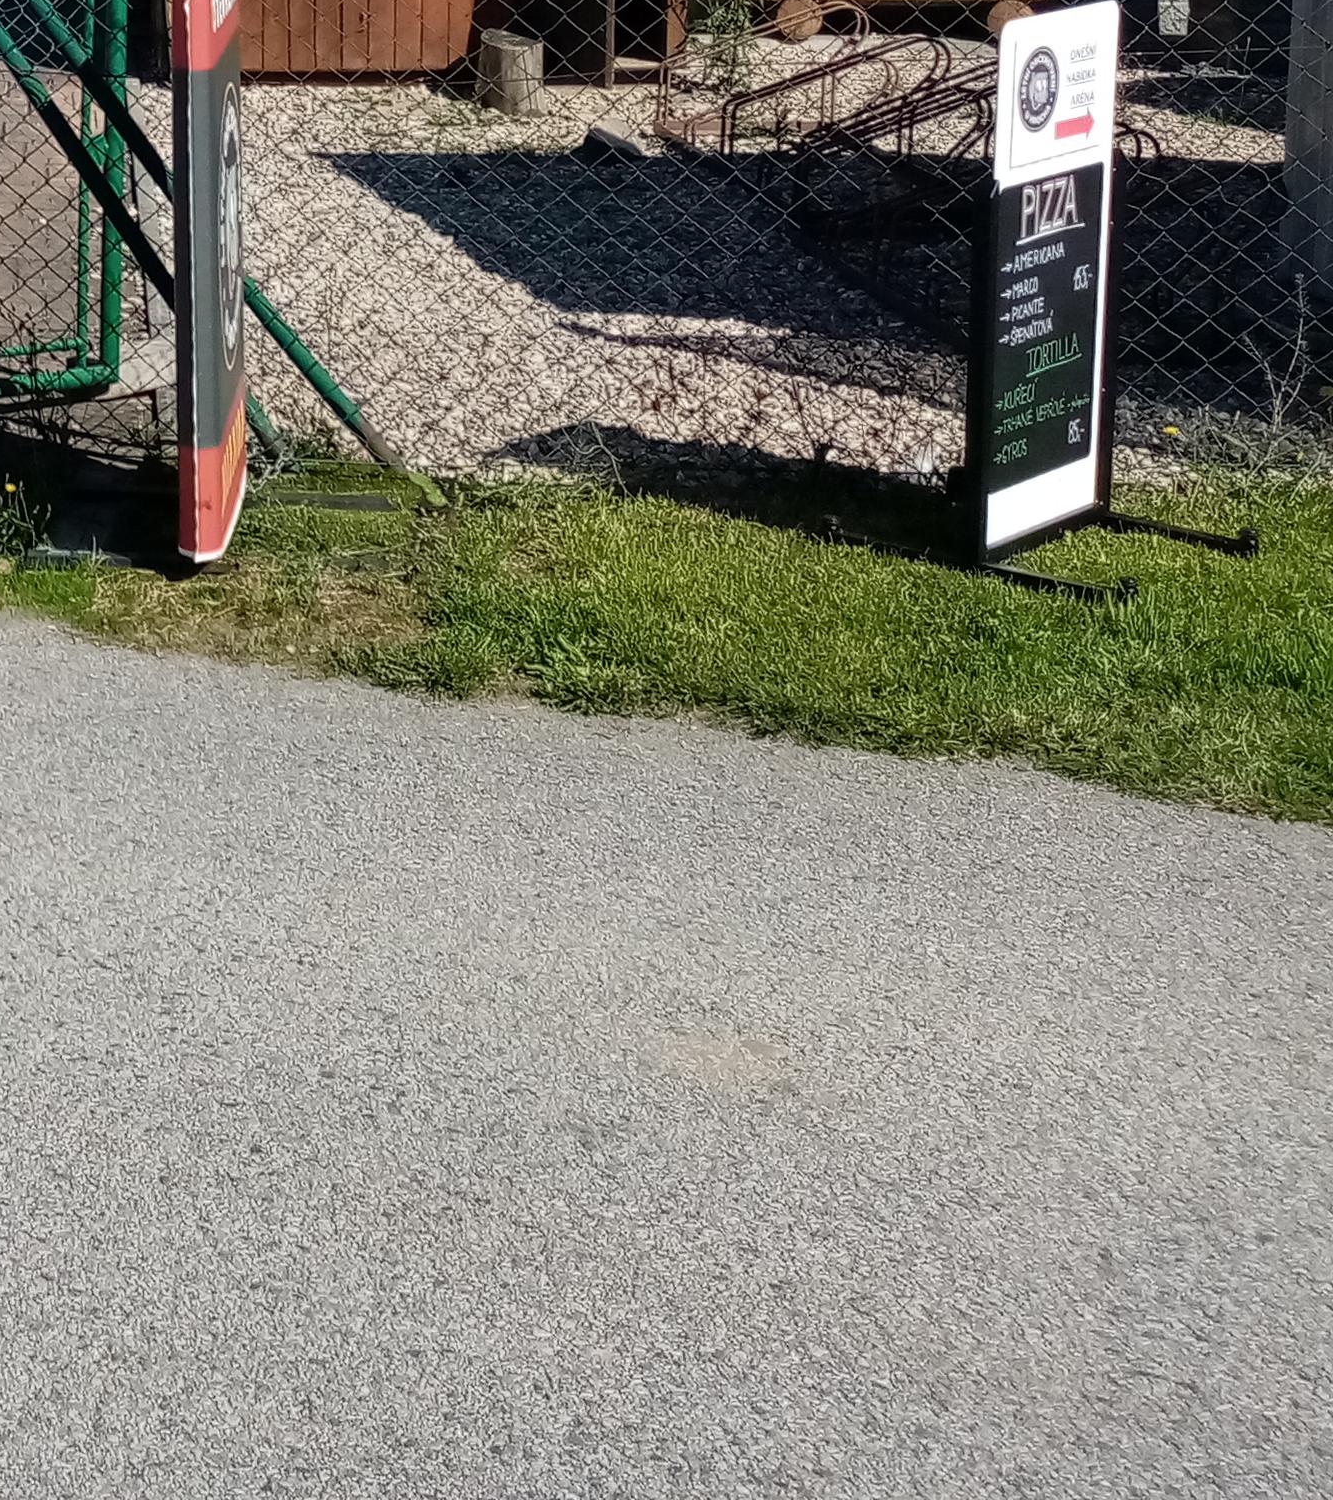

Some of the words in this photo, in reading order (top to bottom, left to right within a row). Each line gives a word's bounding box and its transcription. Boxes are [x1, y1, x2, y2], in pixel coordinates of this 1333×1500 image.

[1020, 174, 1078, 238] PIZZA
[1013, 241, 1066, 274] AMERICANA
[1012, 276, 1039, 300] MARCO
[1011, 296, 1045, 322] PICANTE
[1026, 333, 1079, 371] TORTILLA
